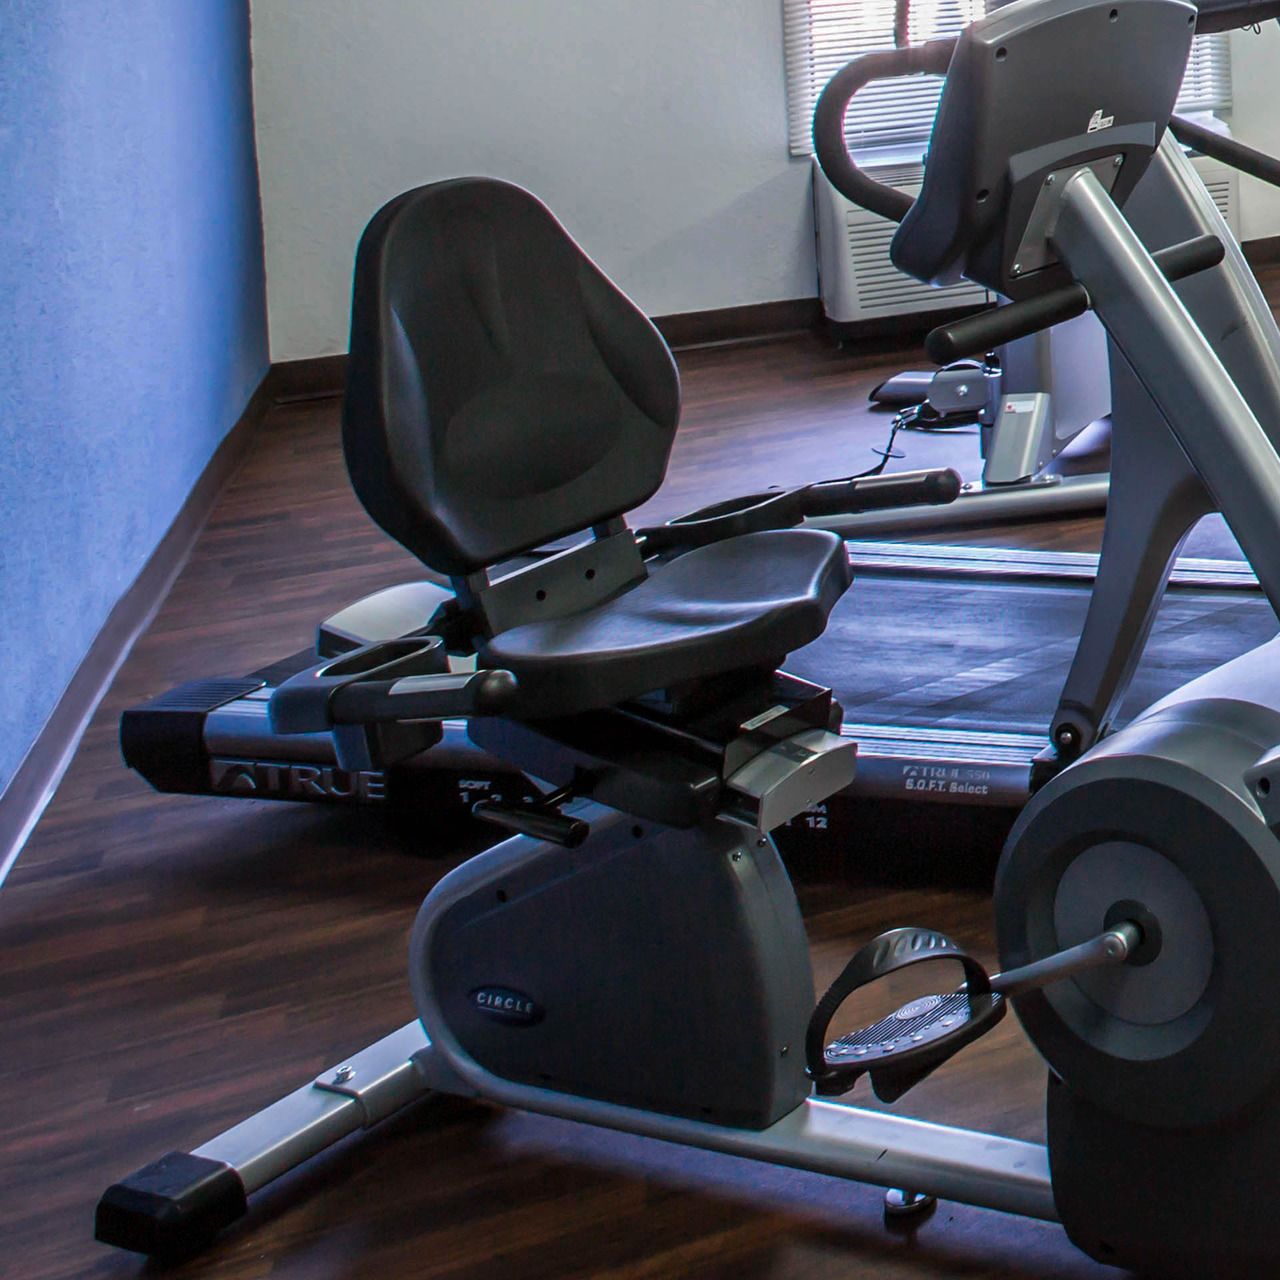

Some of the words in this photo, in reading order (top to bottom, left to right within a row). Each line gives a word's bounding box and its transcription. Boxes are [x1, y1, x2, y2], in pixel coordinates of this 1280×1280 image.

[256, 762, 385, 798] TRUE
[949, 782, 989, 795] Select
[806, 816, 828, 829] 12
[477, 991, 535, 1013] CIRCLE
